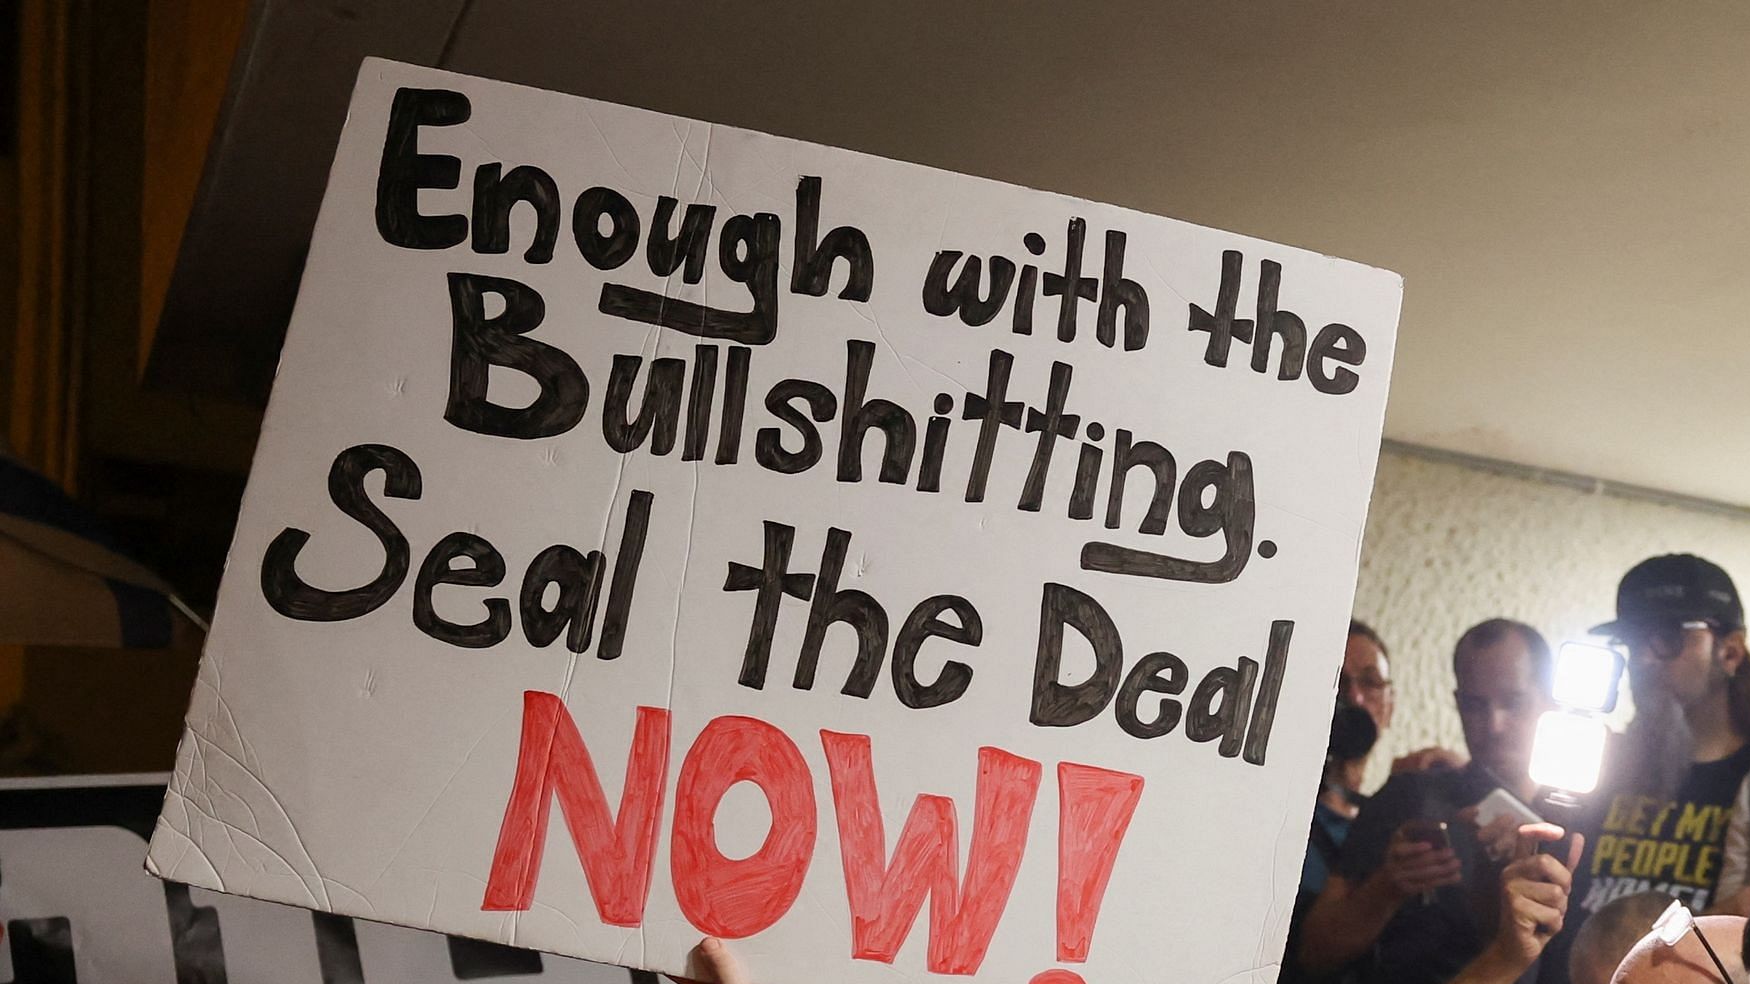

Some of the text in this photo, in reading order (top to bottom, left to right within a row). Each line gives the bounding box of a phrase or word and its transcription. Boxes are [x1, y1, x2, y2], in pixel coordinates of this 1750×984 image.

[375, 87, 1367, 395] Enough with the
[443, 272, 1278, 584] Bullshitting.
[261, 441, 1295, 766] Seal the Deal
[1591, 834, 1719, 886] PEOPLE
